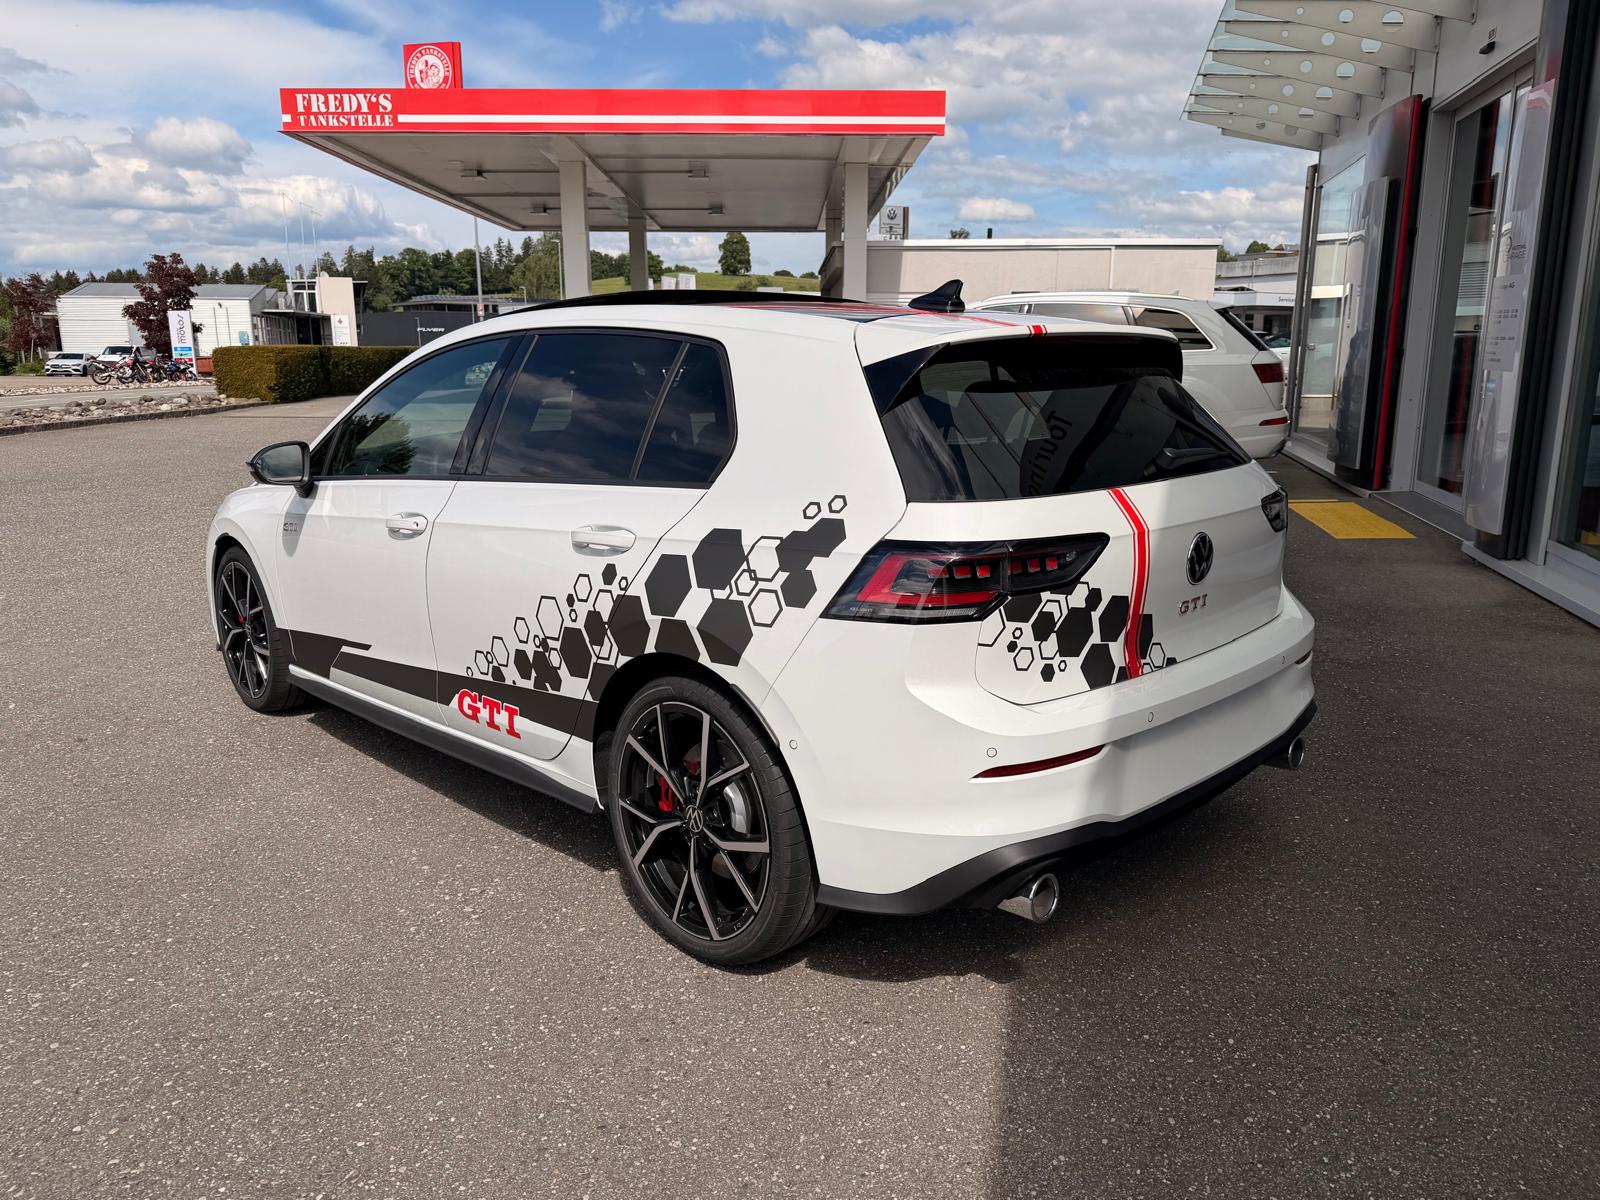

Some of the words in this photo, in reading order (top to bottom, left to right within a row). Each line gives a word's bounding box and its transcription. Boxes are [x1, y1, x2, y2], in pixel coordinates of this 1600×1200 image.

[297, 114, 394, 127] TANKSTELLE
[177, 313, 187, 344] motos
[1178, 593, 1208, 616] GTI
[457, 688, 521, 740] GTI
